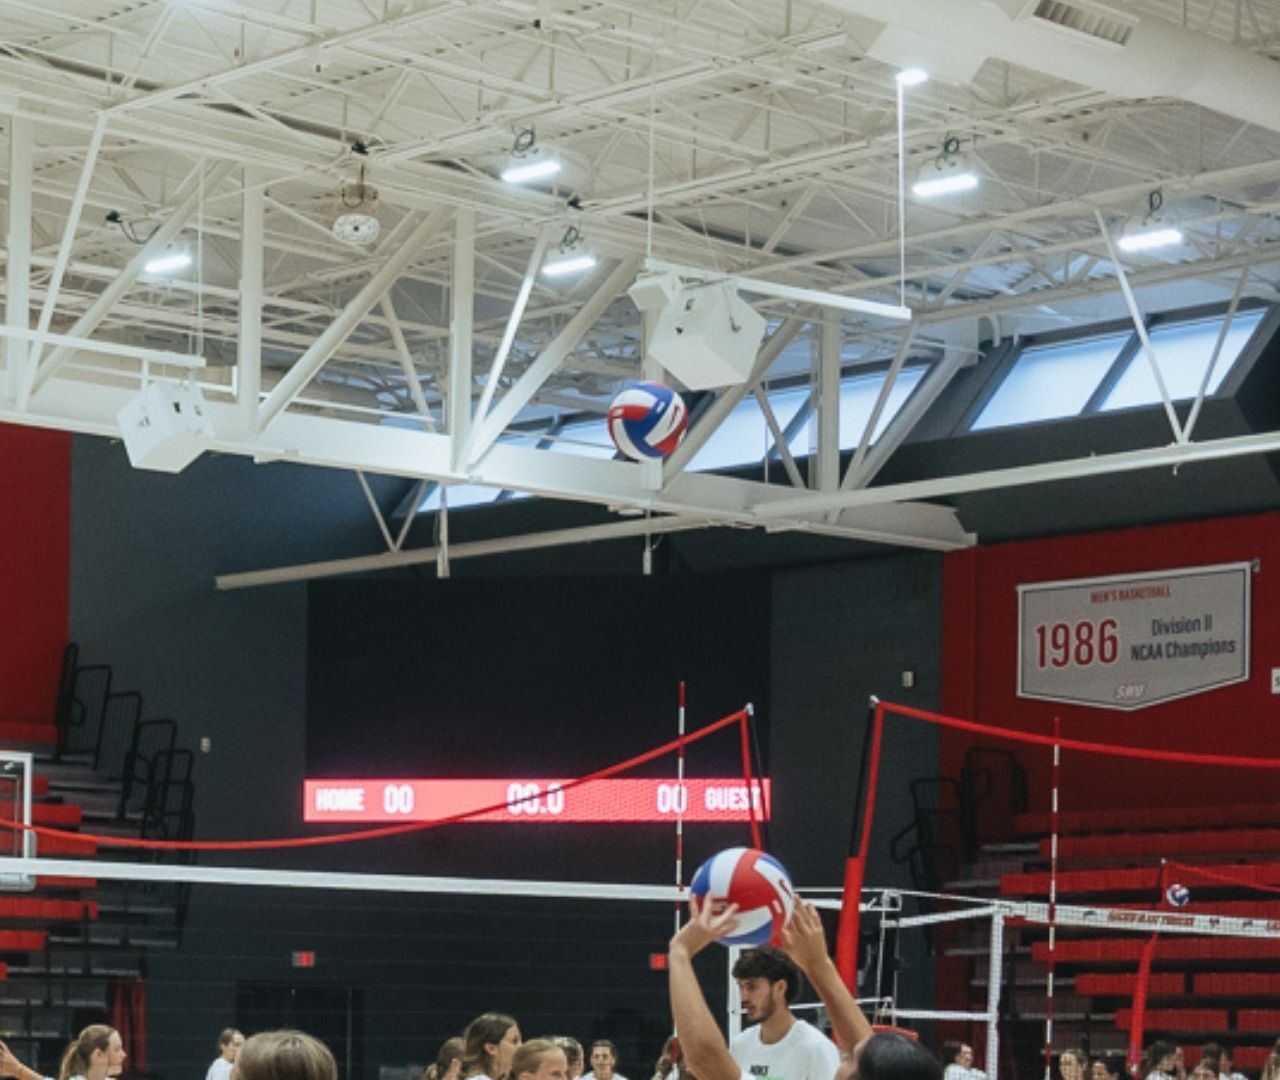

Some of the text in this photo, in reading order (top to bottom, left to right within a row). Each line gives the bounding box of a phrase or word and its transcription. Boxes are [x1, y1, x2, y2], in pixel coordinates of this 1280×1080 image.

[1152, 616, 1201, 636] Division
[1035, 618, 1118, 668] 1986
[1131, 640, 1236, 661] NCAA Champions
[315, 783, 761, 814] HOME 00 00.0 00 GUEST
